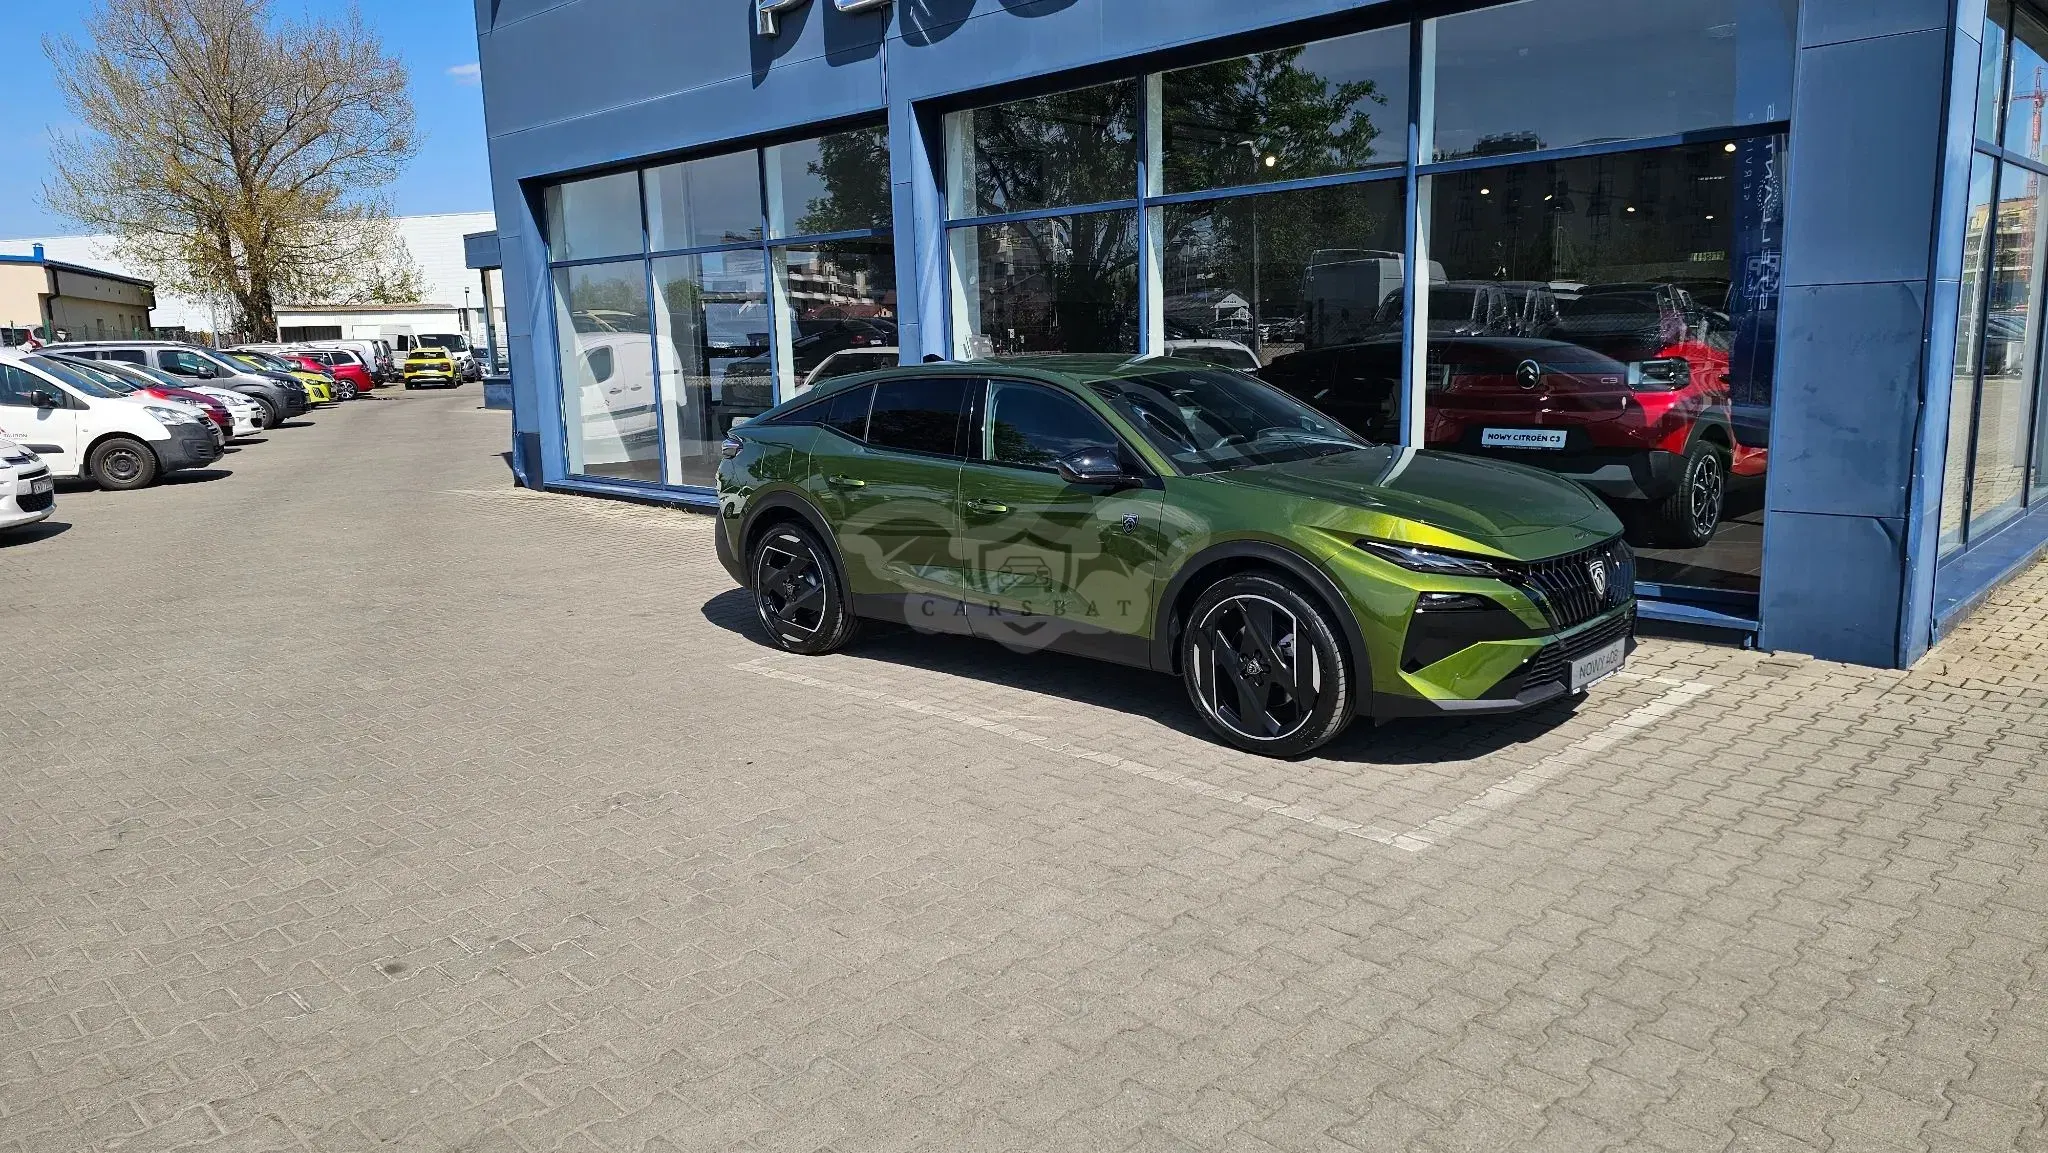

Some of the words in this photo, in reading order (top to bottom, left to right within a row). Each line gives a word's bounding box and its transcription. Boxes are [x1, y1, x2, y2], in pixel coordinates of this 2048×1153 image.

[1487, 433, 1512, 441] NOWY
[1512, 433, 1548, 442] CITROËN
[1549, 435, 1561, 443] C3
[1579, 655, 1606, 680] NOWY
